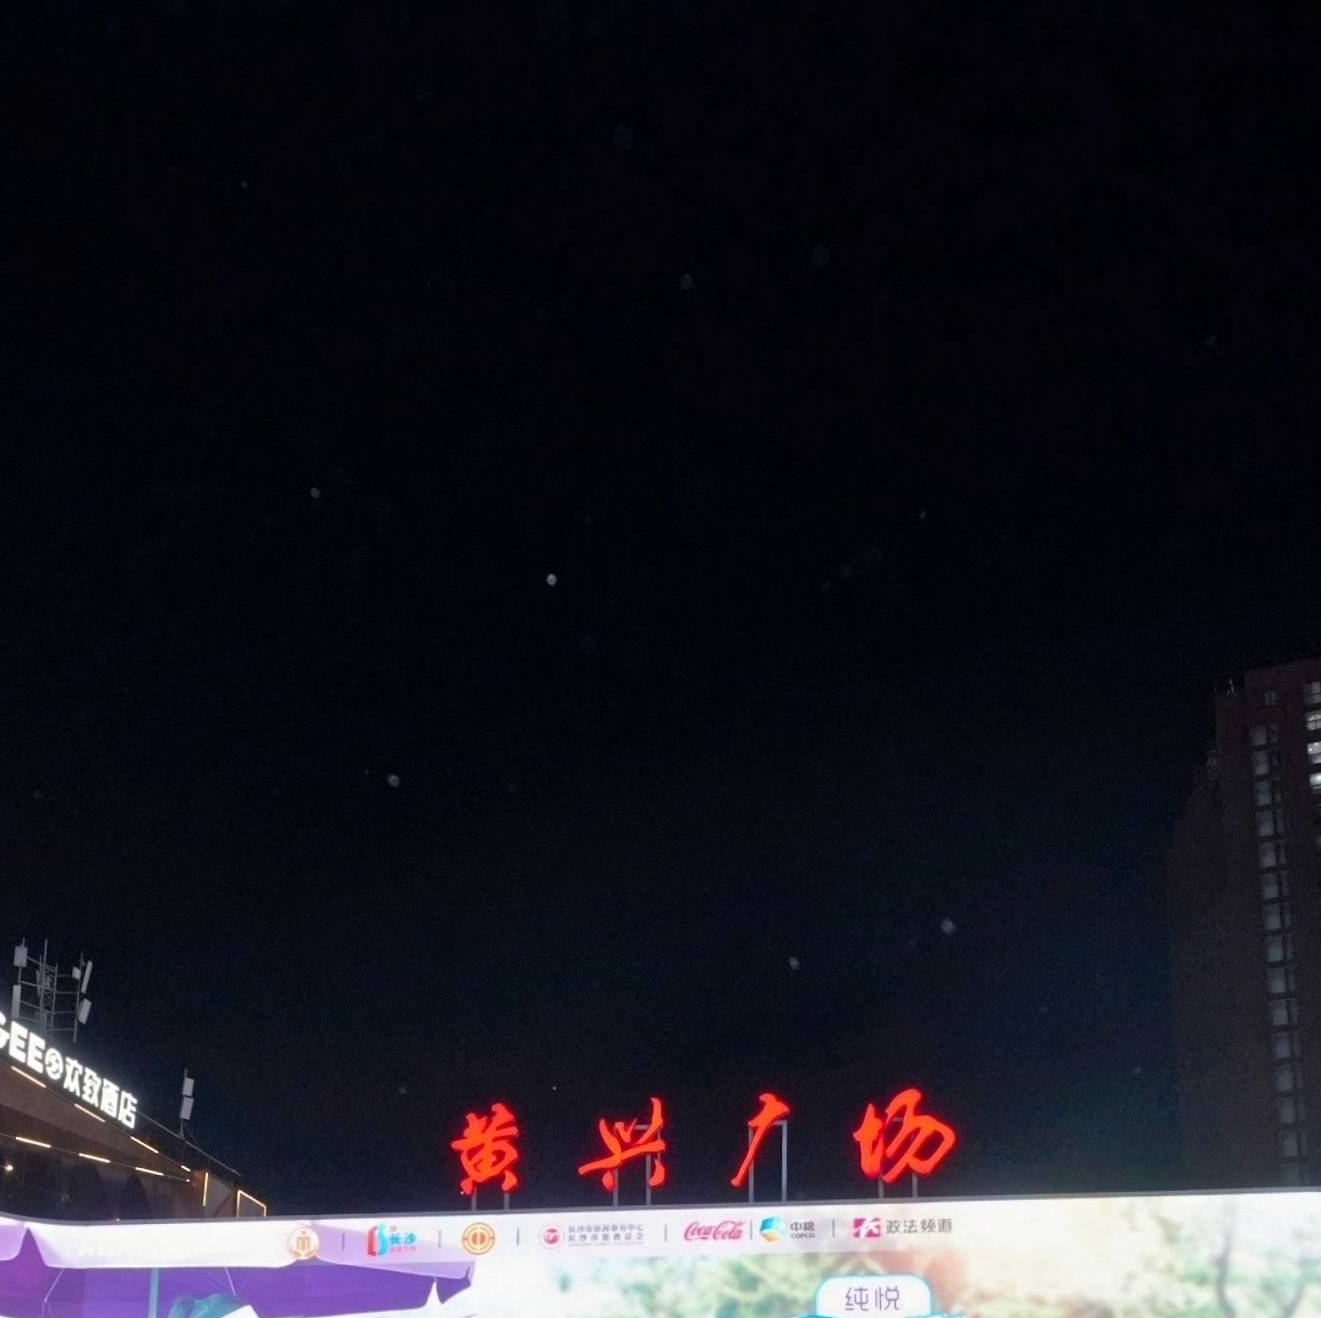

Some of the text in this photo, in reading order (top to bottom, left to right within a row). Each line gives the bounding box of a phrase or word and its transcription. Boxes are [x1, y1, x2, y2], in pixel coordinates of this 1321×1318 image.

[451, 1087, 959, 1195] 黄兴广场
[886, 1218, 953, 1235] 政法频道
[845, 1286, 901, 1313] 纯悦
